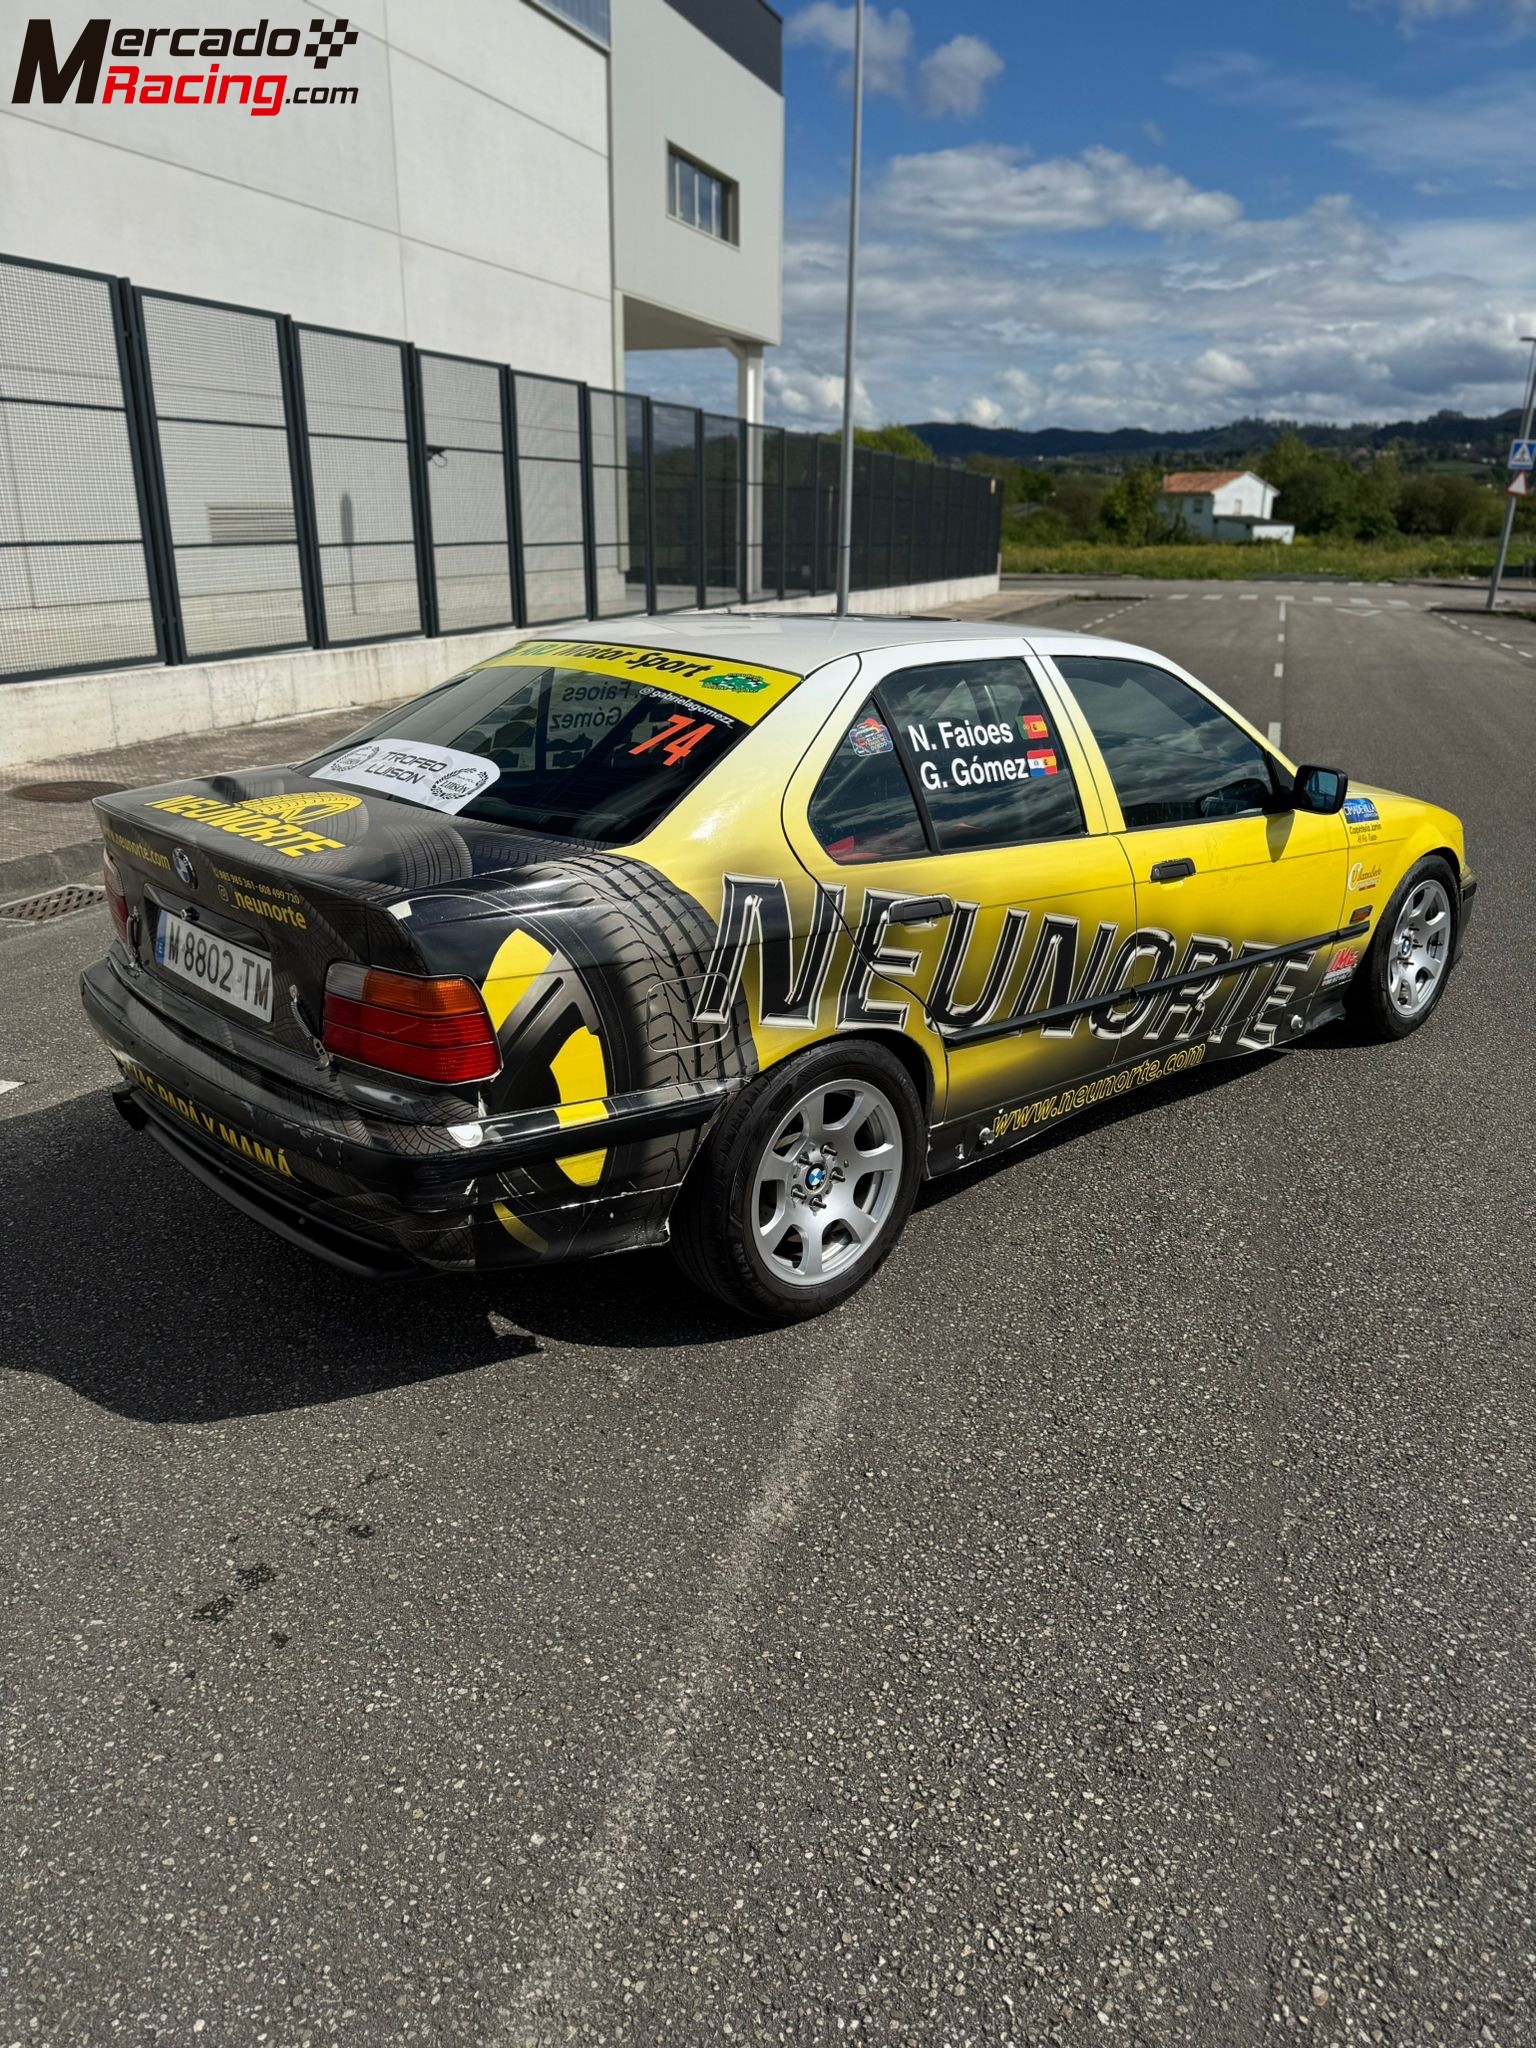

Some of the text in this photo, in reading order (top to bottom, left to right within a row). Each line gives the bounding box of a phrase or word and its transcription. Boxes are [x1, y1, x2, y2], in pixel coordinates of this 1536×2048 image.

[552, 644, 637, 661] Motor
[624, 652, 714, 679] Sport
[629, 713, 715, 766] 74
[907, 724, 937, 752] N.
[938, 719, 1014, 749] Faioes
[364, 763, 427, 785] LUISON
[382, 751, 448, 773] TROFEO
[920, 755, 1029, 790] G. Gómez
[144, 794, 346, 858] NEUNORTE
[168, 921, 271, 1011] M 8802 TM
[692, 872, 1312, 1050] NEUNORTE
[992, 1043, 1206, 1138] www.neunorte.com
